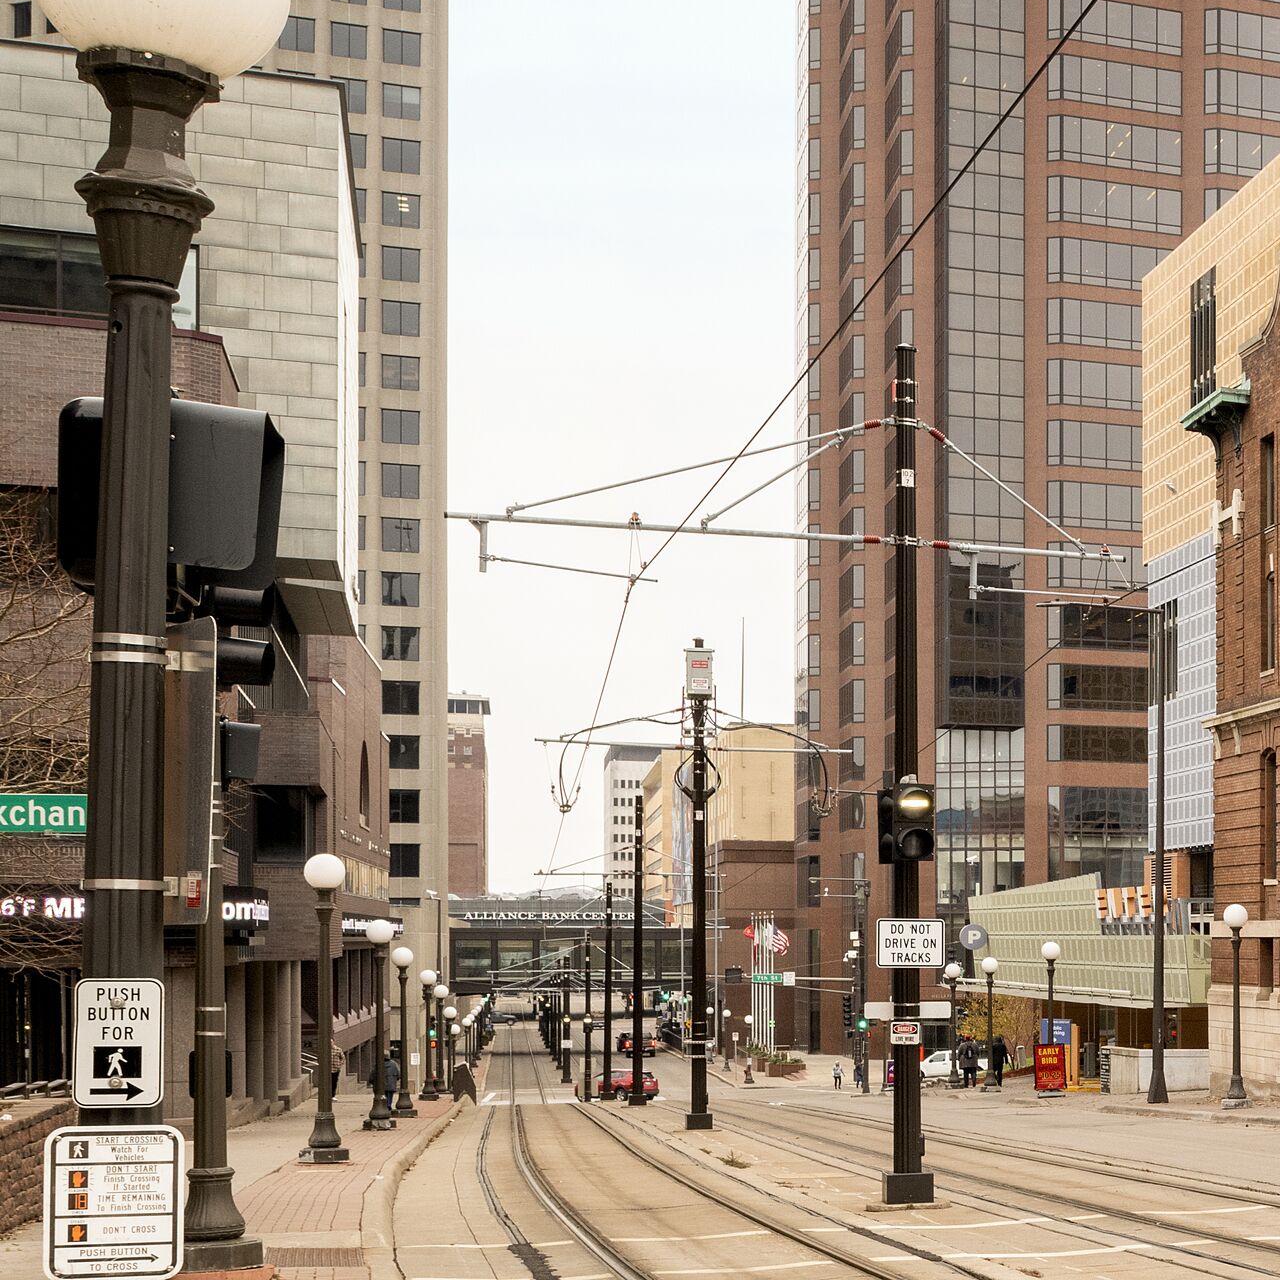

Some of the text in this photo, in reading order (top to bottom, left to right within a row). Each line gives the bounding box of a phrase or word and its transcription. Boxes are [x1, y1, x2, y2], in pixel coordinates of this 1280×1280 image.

[464, 911, 635, 920] ALLIANCE BANK CENTER
[890, 924, 931, 935] DO NOT
[885, 938, 937, 949] DRIVE ON
[891, 952, 931, 963] TRACKS
[97, 988, 141, 1001] PUSH
[88, 1007, 149, 1021] BUTTON
[102, 1026, 134, 1040] FOR
[1038, 1047, 1059, 1056] EARLY
[1041, 1057, 1058, 1065] BIRD
[124, 1136, 164, 1144] CROSSING
[104, 1175, 160, 1183] Finish Crossing
[123, 1183, 150, 1191] Started
[97, 1204, 105, 1212] To
[137, 1203, 166, 1211] Crossing
[103, 1225, 156, 1235] DON'T CROSS
[80, 1247, 148, 1257] PUSH BUTTON
[90, 1262, 138, 1272] TO CROSS
